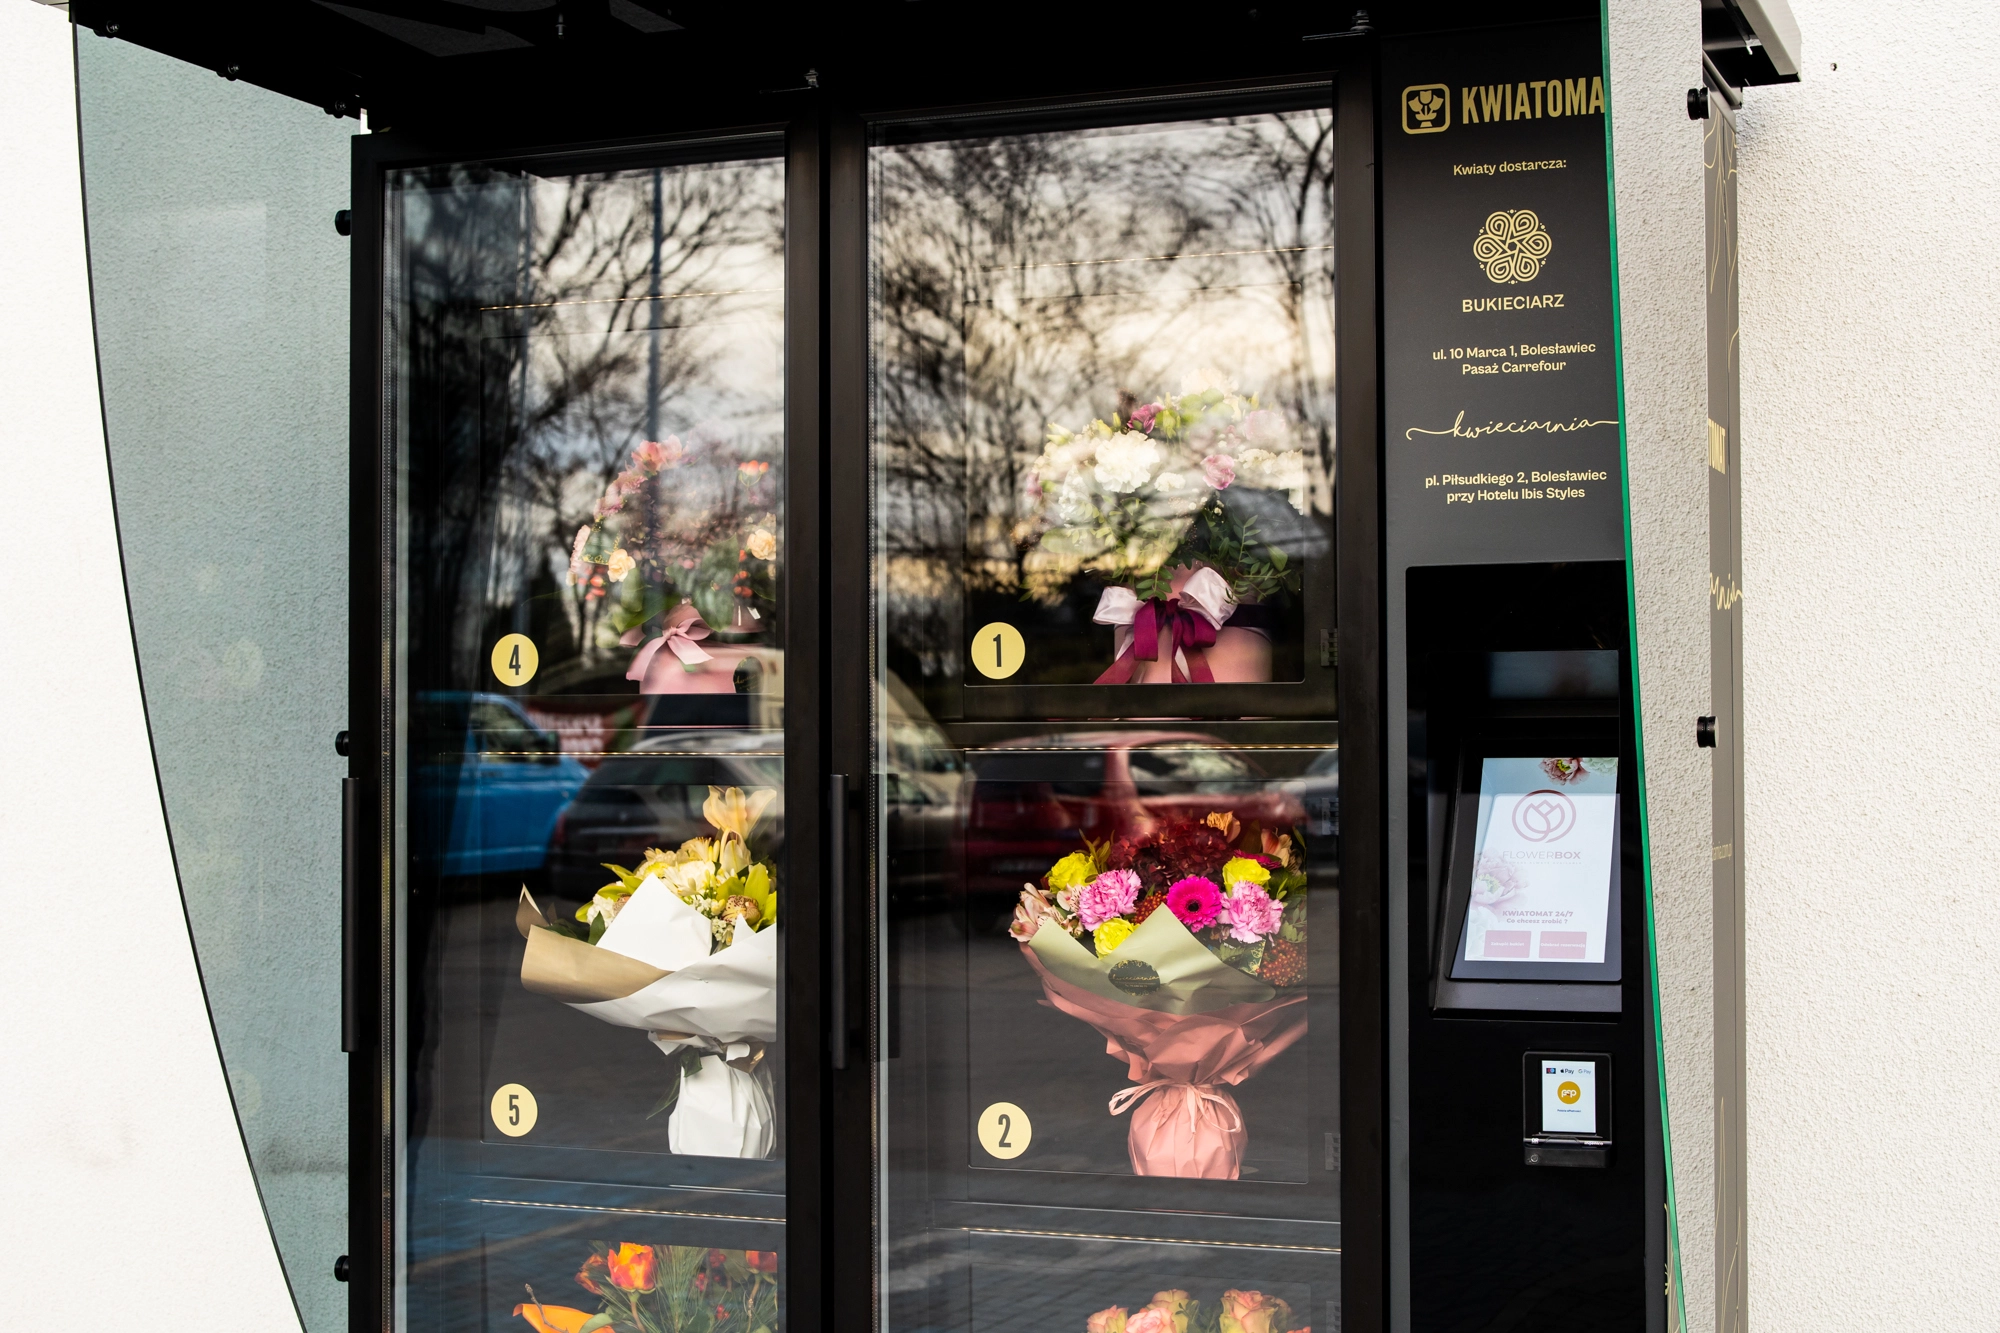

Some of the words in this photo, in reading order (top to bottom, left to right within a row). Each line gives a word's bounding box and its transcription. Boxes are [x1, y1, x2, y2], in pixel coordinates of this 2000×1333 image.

[1453, 162, 1496, 176] Kwiaty
[1499, 159, 1567, 173] dostarcza:
[1462, 293, 1565, 313] BUKIECIARZ
[1432, 348, 1447, 360] ul.
[1449, 347, 1464, 359] 10
[1466, 346, 1507, 359] Marca
[1509, 345, 1518, 358] 1,
[1520, 342, 1596, 356] Bolesławiec
[1462, 363, 1499, 375] Pasaż
[1501, 360, 1567, 373] Carrefour
[1405, 410, 1619, 441] kwieciarnia
[1425, 475, 1439, 489] pl.
[1442, 471, 1514, 486] Piłsudkiego
[1517, 471, 1529, 484] 2,
[1531, 469, 1608, 483] Bolesławiec
[1446, 491, 1475, 504] przy
[1477, 488, 1519, 501] Hotelu
[1521, 488, 1544, 500] Ibis
[1546, 487, 1586, 500] Styles
[509, 645, 521, 676] 4
[993, 634, 1002, 668] 1
[509, 1094, 520, 1127] 5
[998, 1114, 1012, 1148] 2
